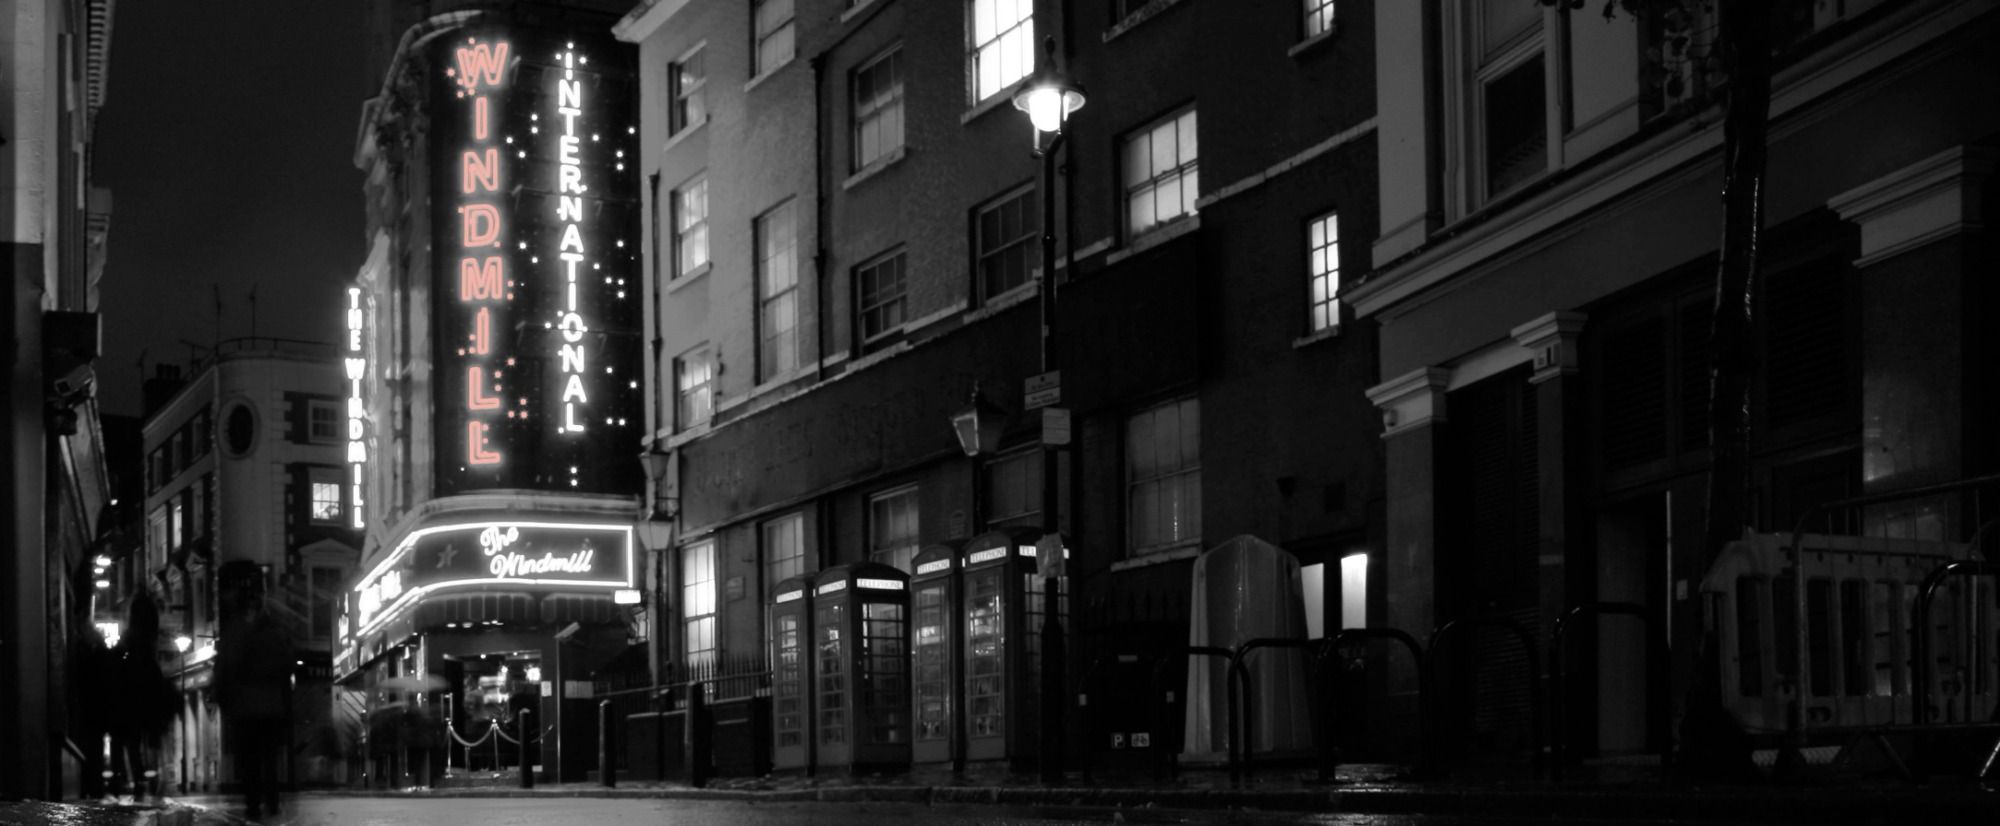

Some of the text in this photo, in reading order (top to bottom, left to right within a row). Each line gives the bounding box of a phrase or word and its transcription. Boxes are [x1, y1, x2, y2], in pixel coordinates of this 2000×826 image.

[457, 43, 508, 464] WINDMILL
[558, 51, 587, 432] INTERNATIONAL
[345, 288, 367, 528] THE WINDMILL
[480, 526, 519, 556] The
[490, 549, 593, 579] Windmill
